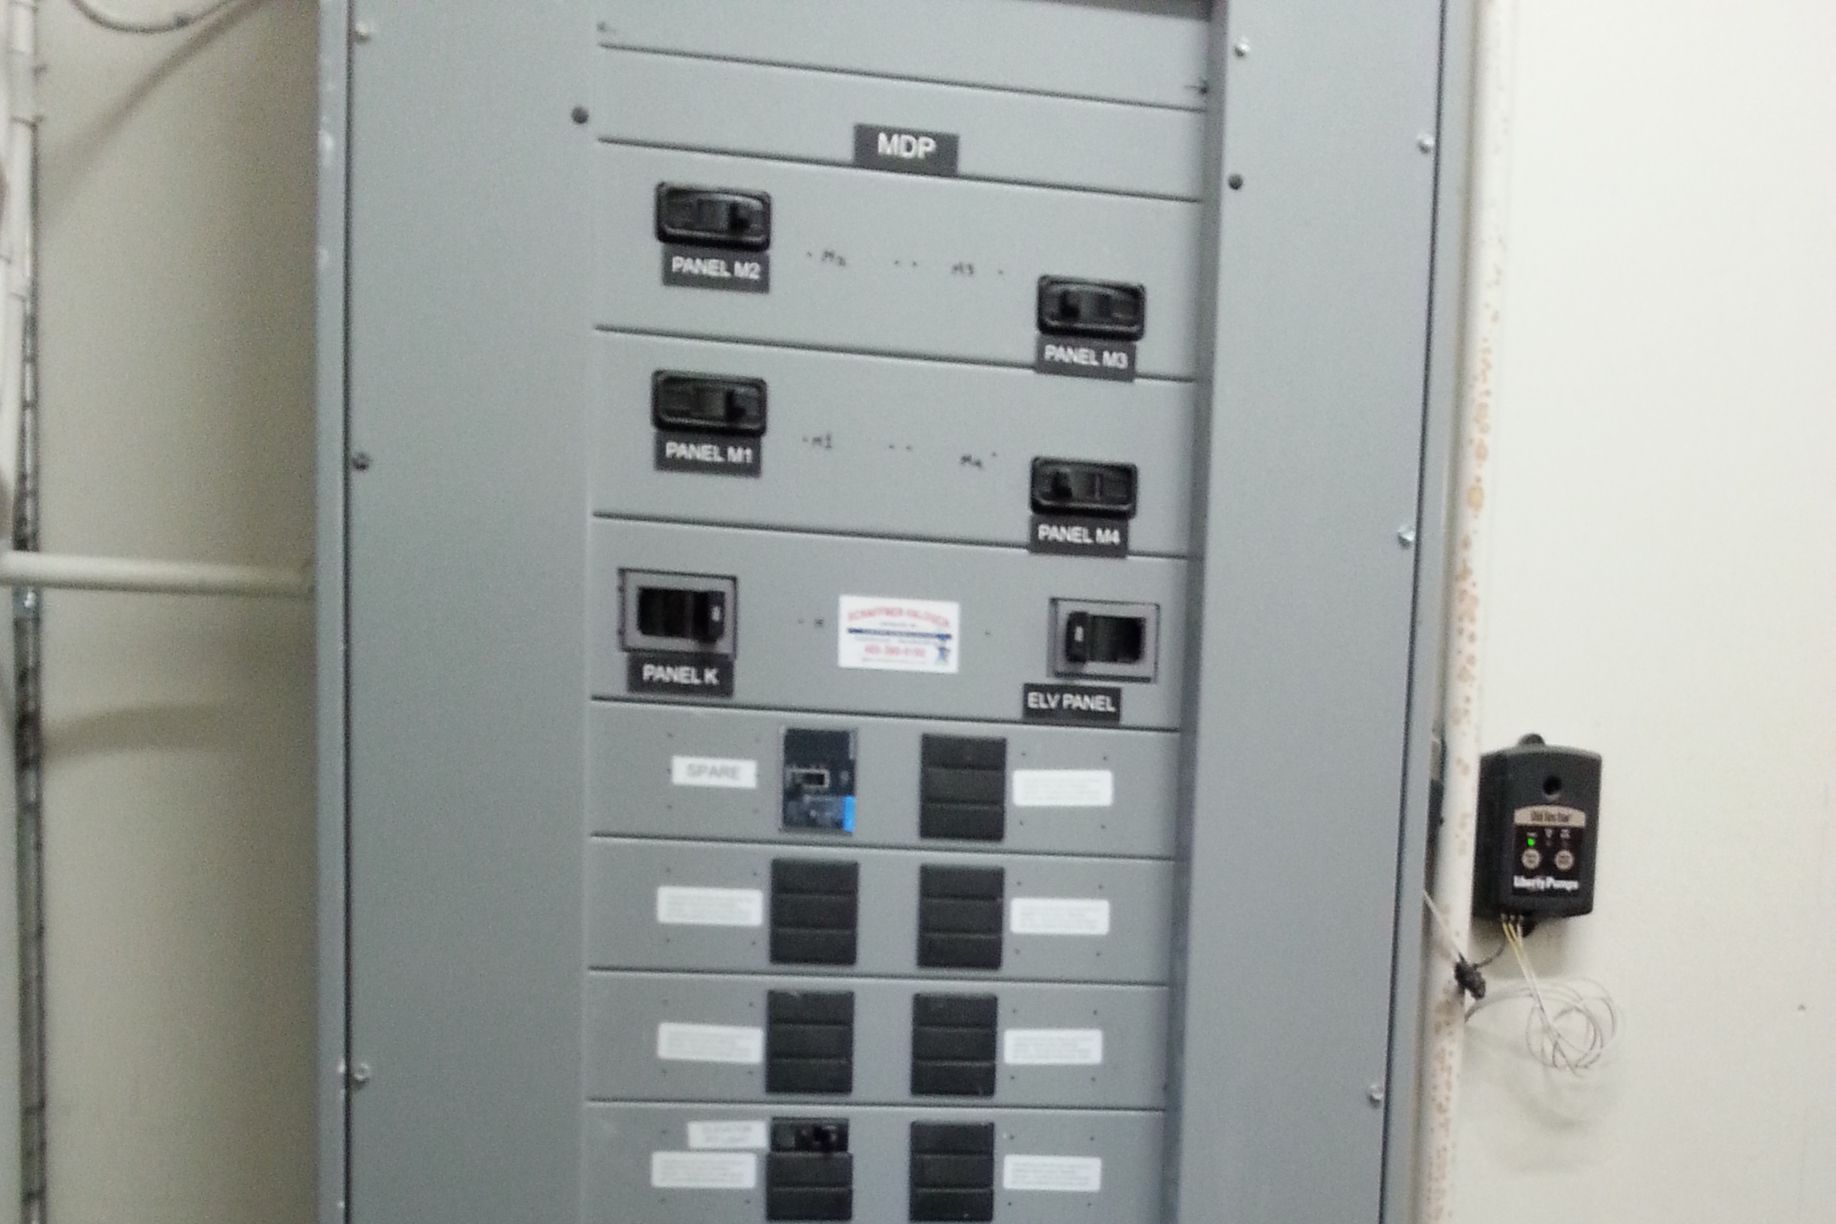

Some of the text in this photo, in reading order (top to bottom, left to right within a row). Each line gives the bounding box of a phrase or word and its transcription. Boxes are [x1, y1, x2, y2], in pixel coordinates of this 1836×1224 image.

[877, 132, 936, 161] MDP
[671, 255, 761, 280] PANEL M2
[1044, 344, 1128, 370] PANEL M3
[665, 441, 753, 464] PANEL M1
[1037, 523, 1120, 545] PANEL M4
[642, 663, 720, 686] PANEL K
[1027, 691, 1117, 713] ELV PANEL
[687, 762, 740, 780] SPARE
